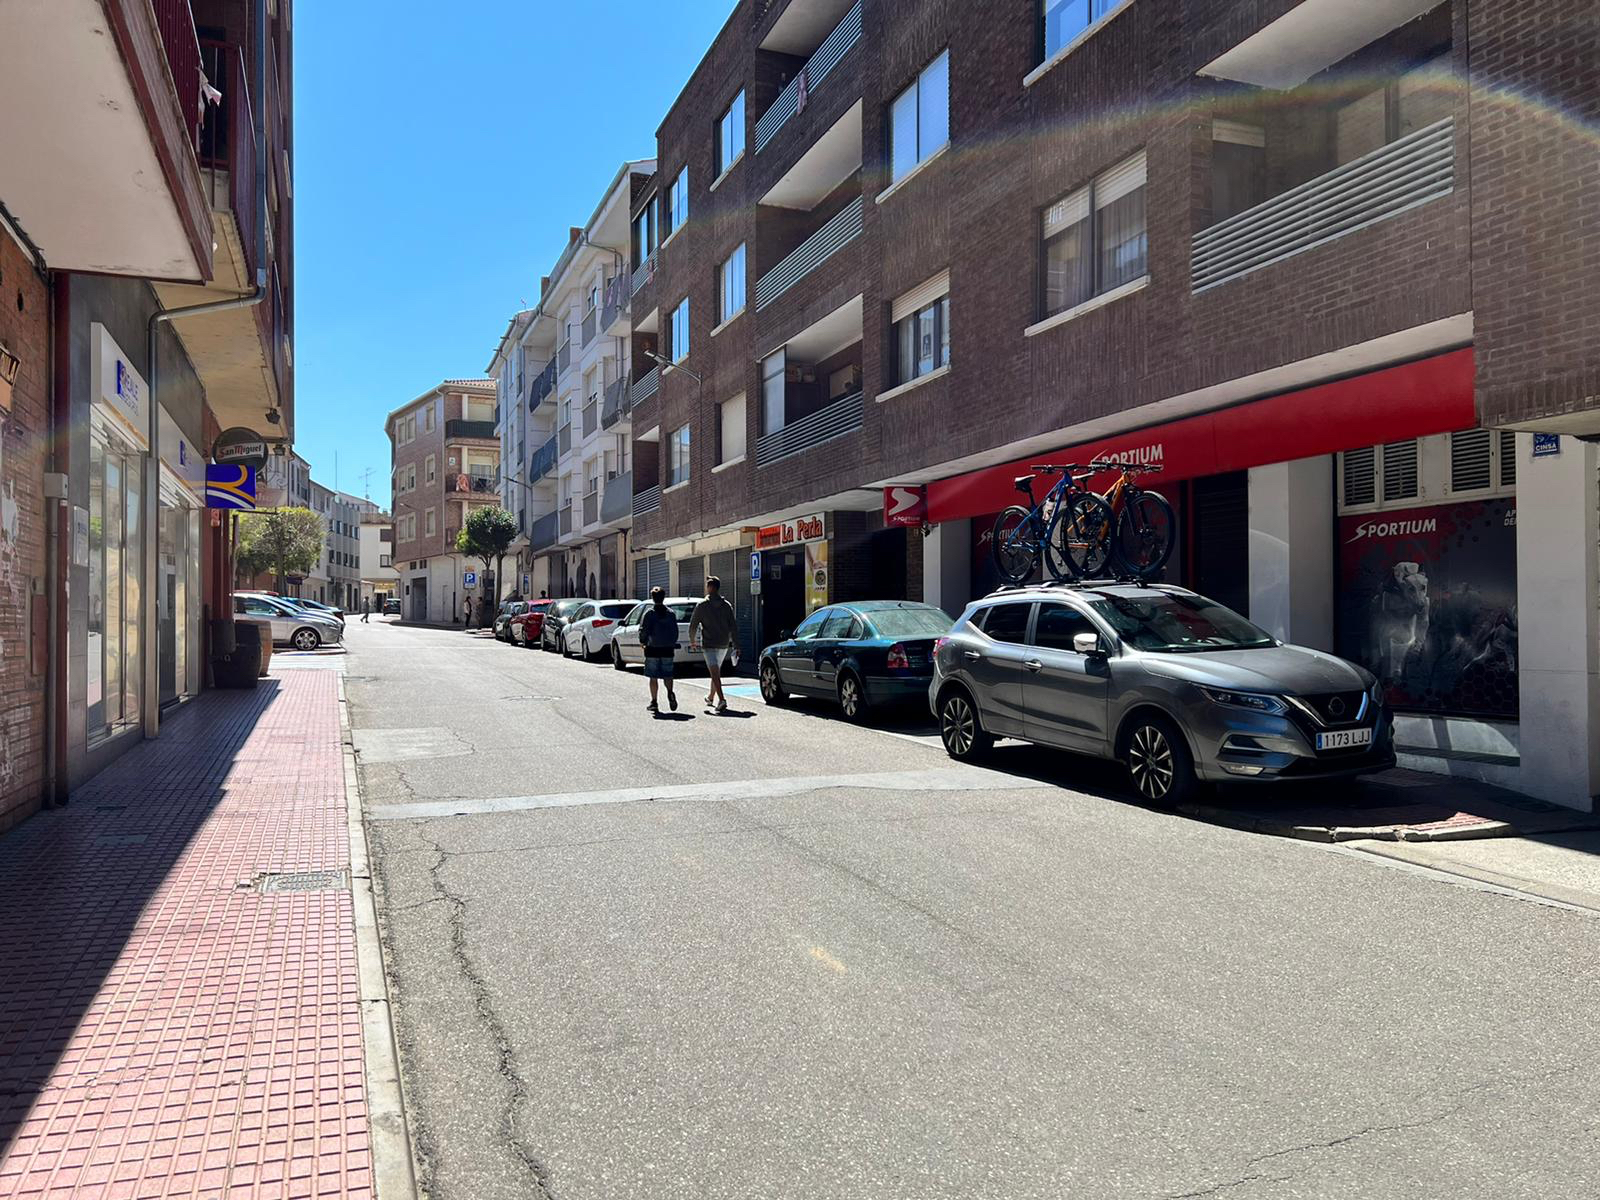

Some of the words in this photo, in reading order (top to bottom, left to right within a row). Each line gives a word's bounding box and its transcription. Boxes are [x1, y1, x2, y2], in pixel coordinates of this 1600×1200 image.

[782, 523, 795, 544] La
[797, 515, 824, 541] Perla
[1343, 518, 1437, 545] SPORTIUM
[1325, 732, 1350, 748] 1173
[1352, 730, 1370, 745] LJJ
